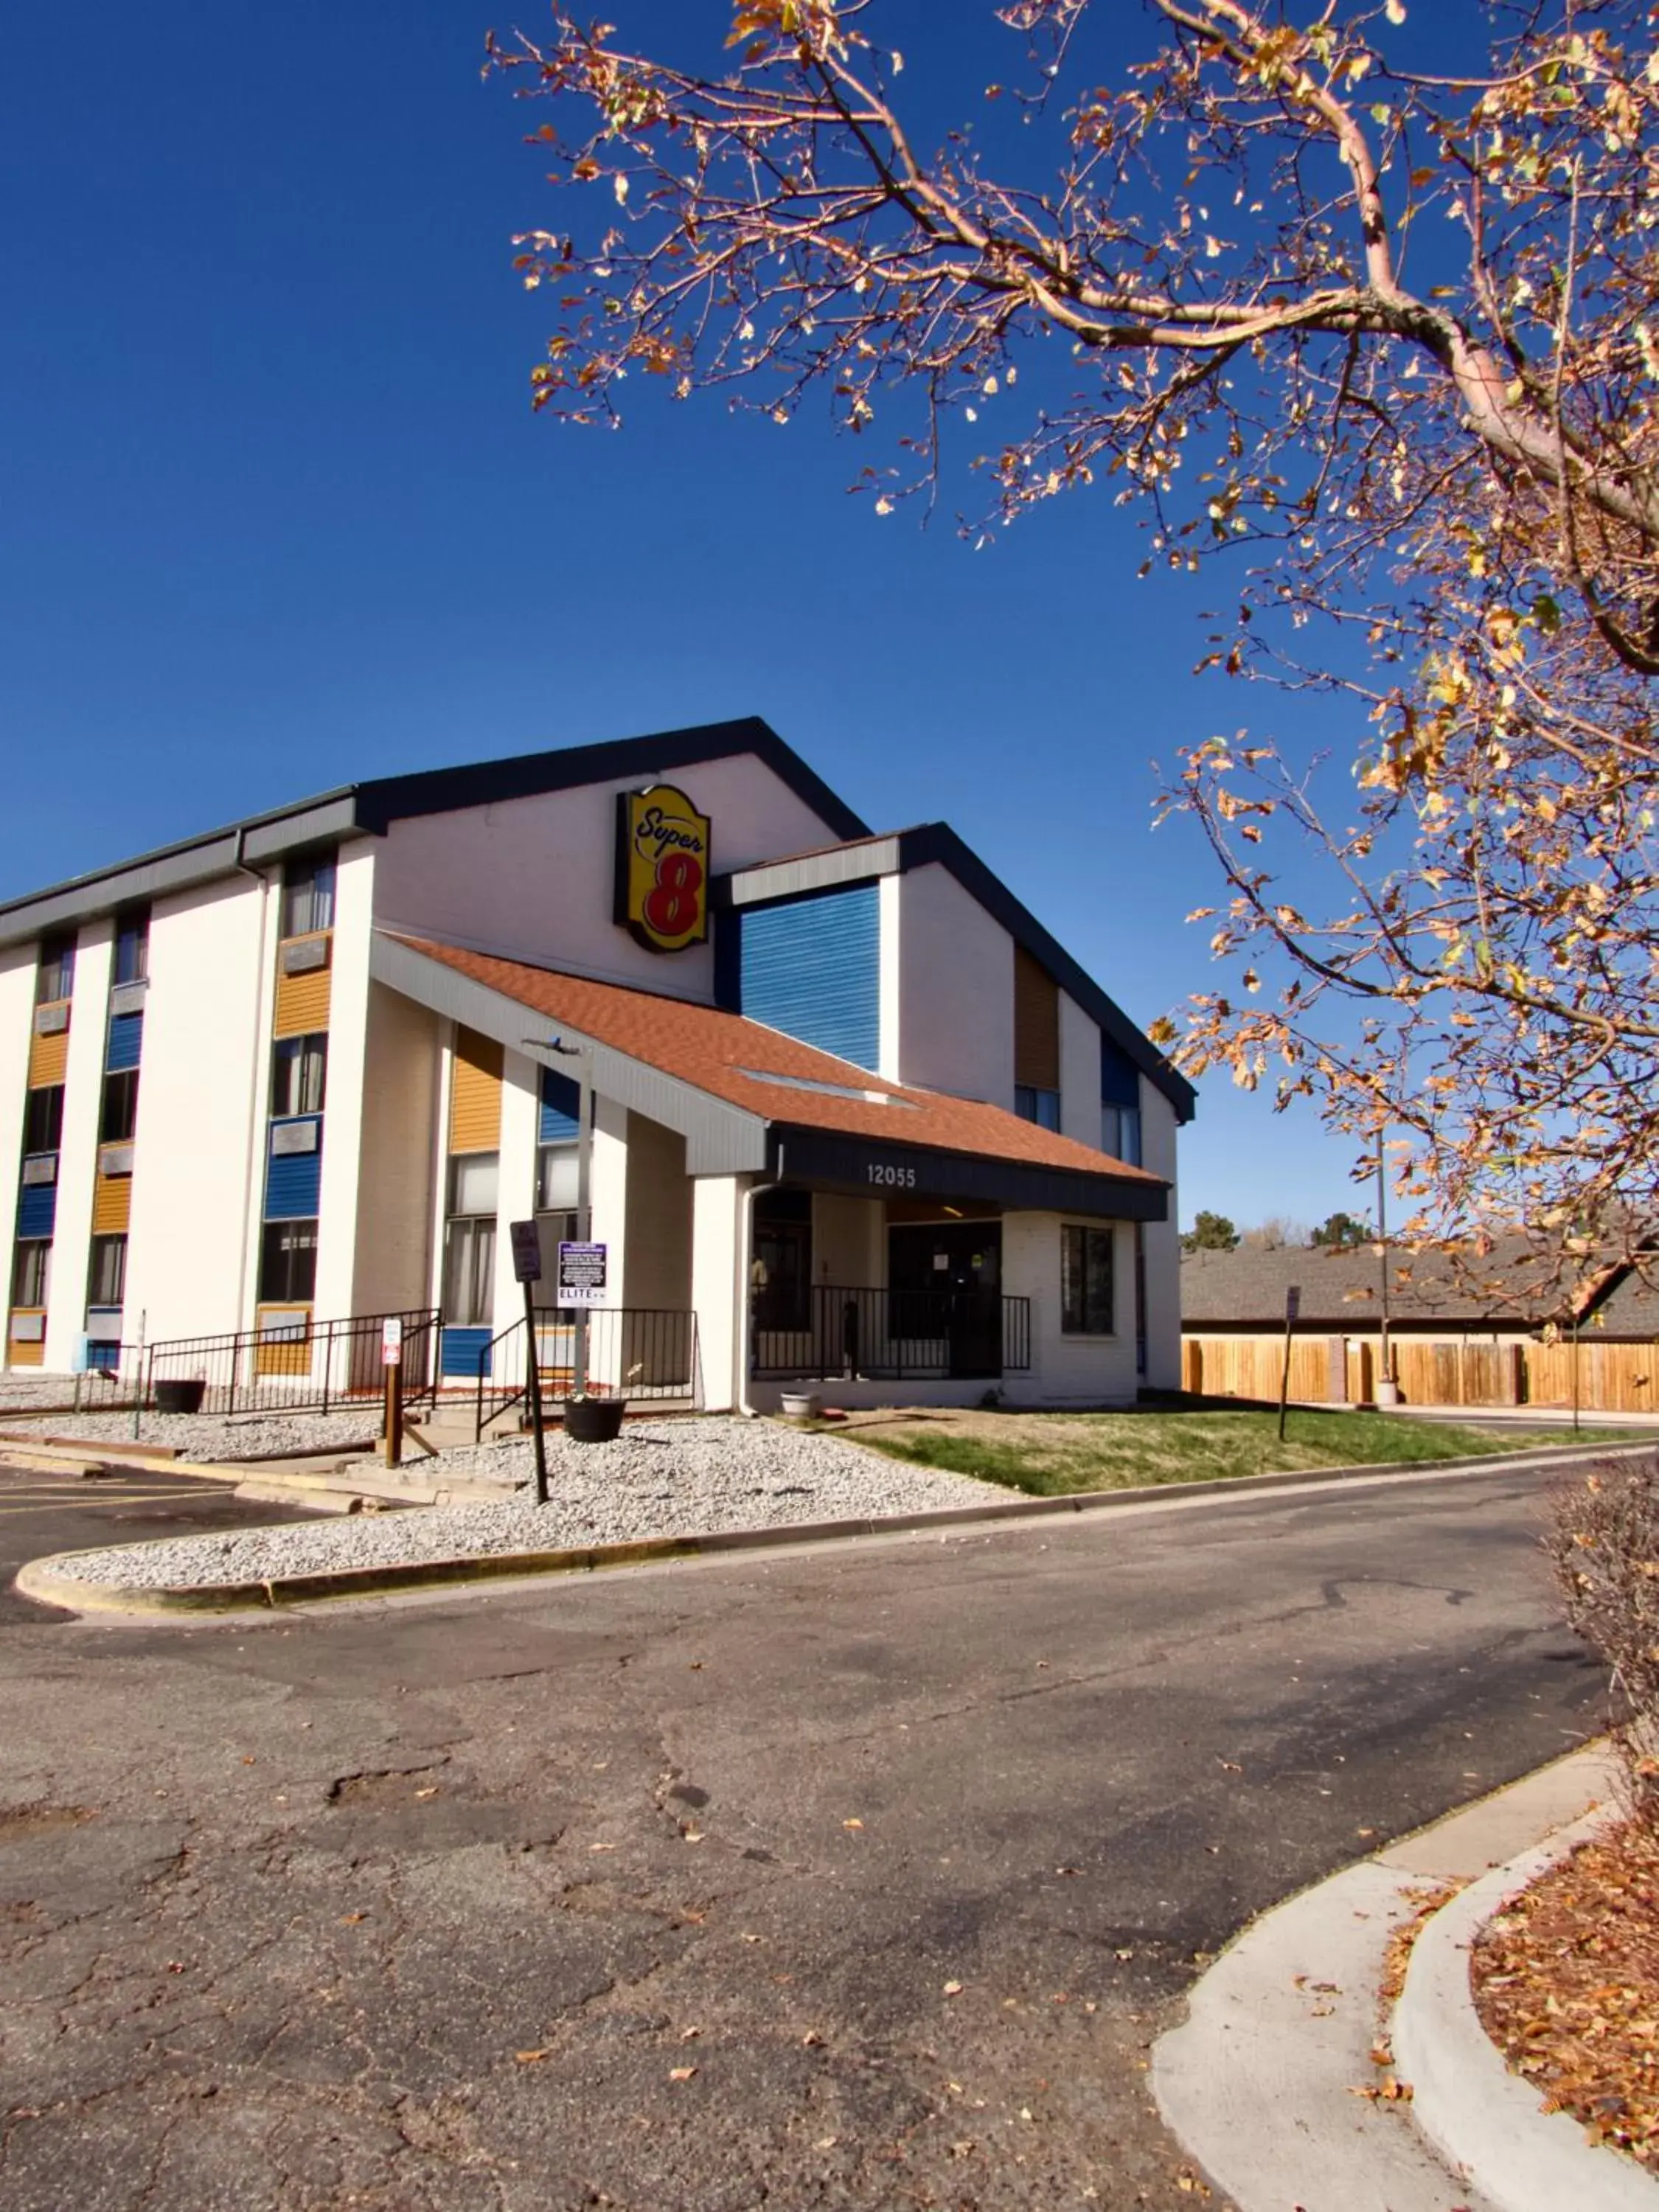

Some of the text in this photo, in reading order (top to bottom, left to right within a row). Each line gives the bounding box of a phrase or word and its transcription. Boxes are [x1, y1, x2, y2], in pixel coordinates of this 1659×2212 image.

[636, 807, 703, 858] Super
[644, 852, 702, 936] 8
[868, 1164, 916, 1188] 12055
[560, 1288, 591, 1298] ELITE
